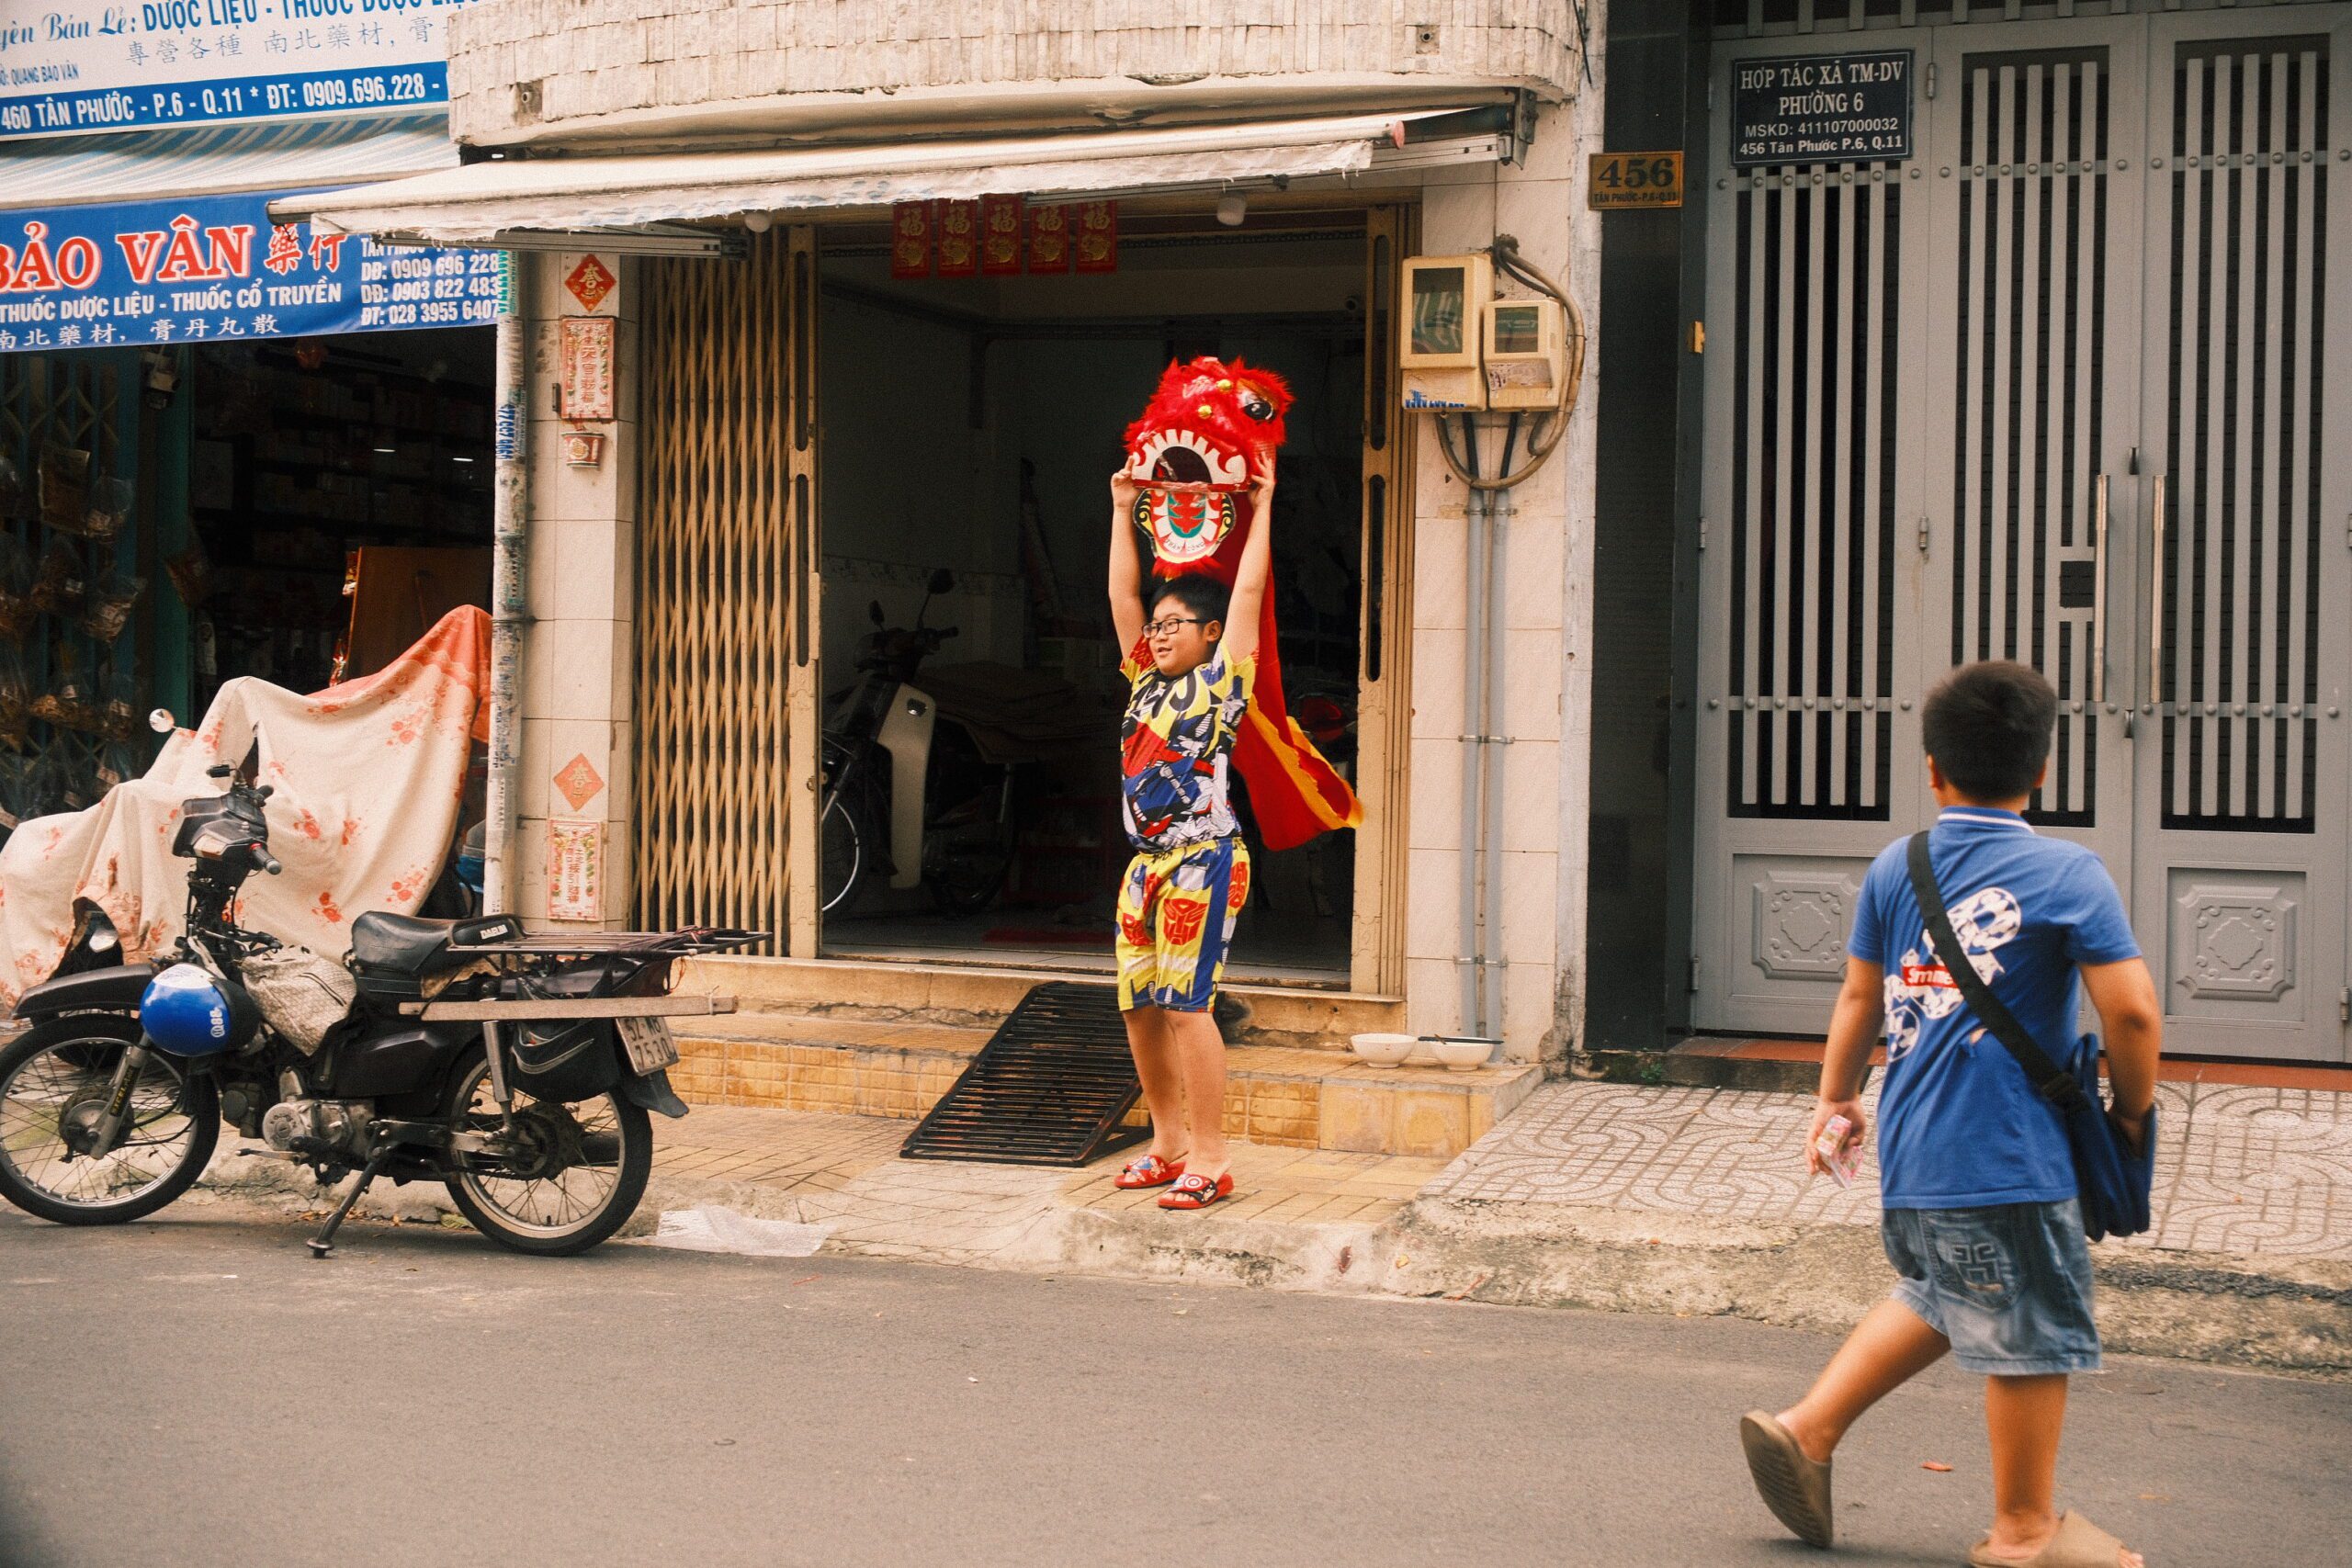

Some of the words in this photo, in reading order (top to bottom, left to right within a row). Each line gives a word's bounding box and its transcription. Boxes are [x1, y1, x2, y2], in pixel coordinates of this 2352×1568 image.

[42, 13, 91, 41] Bán
[98, 6, 136, 35] Lẻ:
[142, 0, 201, 34] DƯỢC
[126, 34, 243, 66] 專營各種
[1741, 66, 1775, 93] HỢP
[1781, 62, 1814, 87] TÁC
[1819, 61, 1843, 85] XÃ
[1849, 61, 1904, 84] TM-DV
[2, 105, 31, 130] 460
[35, 96, 72, 127] TÂN
[75, 90, 135, 124] PHƯỚC
[153, 92, 184, 118] P.6
[202, 86, 243, 115] Q.11
[266, 83, 298, 109] ĐT:
[302, 73, 426, 107] 0909.696.228
[1779, 89, 1849, 116] PHƯỜNG
[1853, 92, 1864, 112] 6
[1746, 123, 1793, 138] MSKD:
[1798, 118, 1898, 135] 411107000032
[1740, 142, 1765, 155] 456
[1770, 141, 1793, 153] Tân
[1798, 139, 1838, 152] Phước
[1842, 137, 1868, 152] P.6,
[1871, 135, 1903, 150] Q.11
[1598, 157, 1675, 188] 456
[115, 213, 256, 284] VÂN
[361, 262, 387, 281] DĐ:
[391, 258, 432, 279] 0909
[435, 255, 465, 276] 696
[469, 253, 499, 274] 228
[0, 294, 56, 323] THUỐC
[60, 295, 109, 321] DƯỢC
[114, 290, 154, 318] LIỆU
[171, 283, 232, 311] THUỐC
[236, 277, 262, 309] CỔ
[266, 276, 342, 307] TRUYỀN
[361, 285, 389, 303] DĐ:
[392, 280, 430, 301] 0903
[434, 278, 464, 299] 822
[468, 276, 499, 297] 483
[361, 306, 384, 325] ĐT:
[389, 304, 416, 324] 028
[421, 301, 458, 321] 3955
[462, 299, 500, 320] 6407
